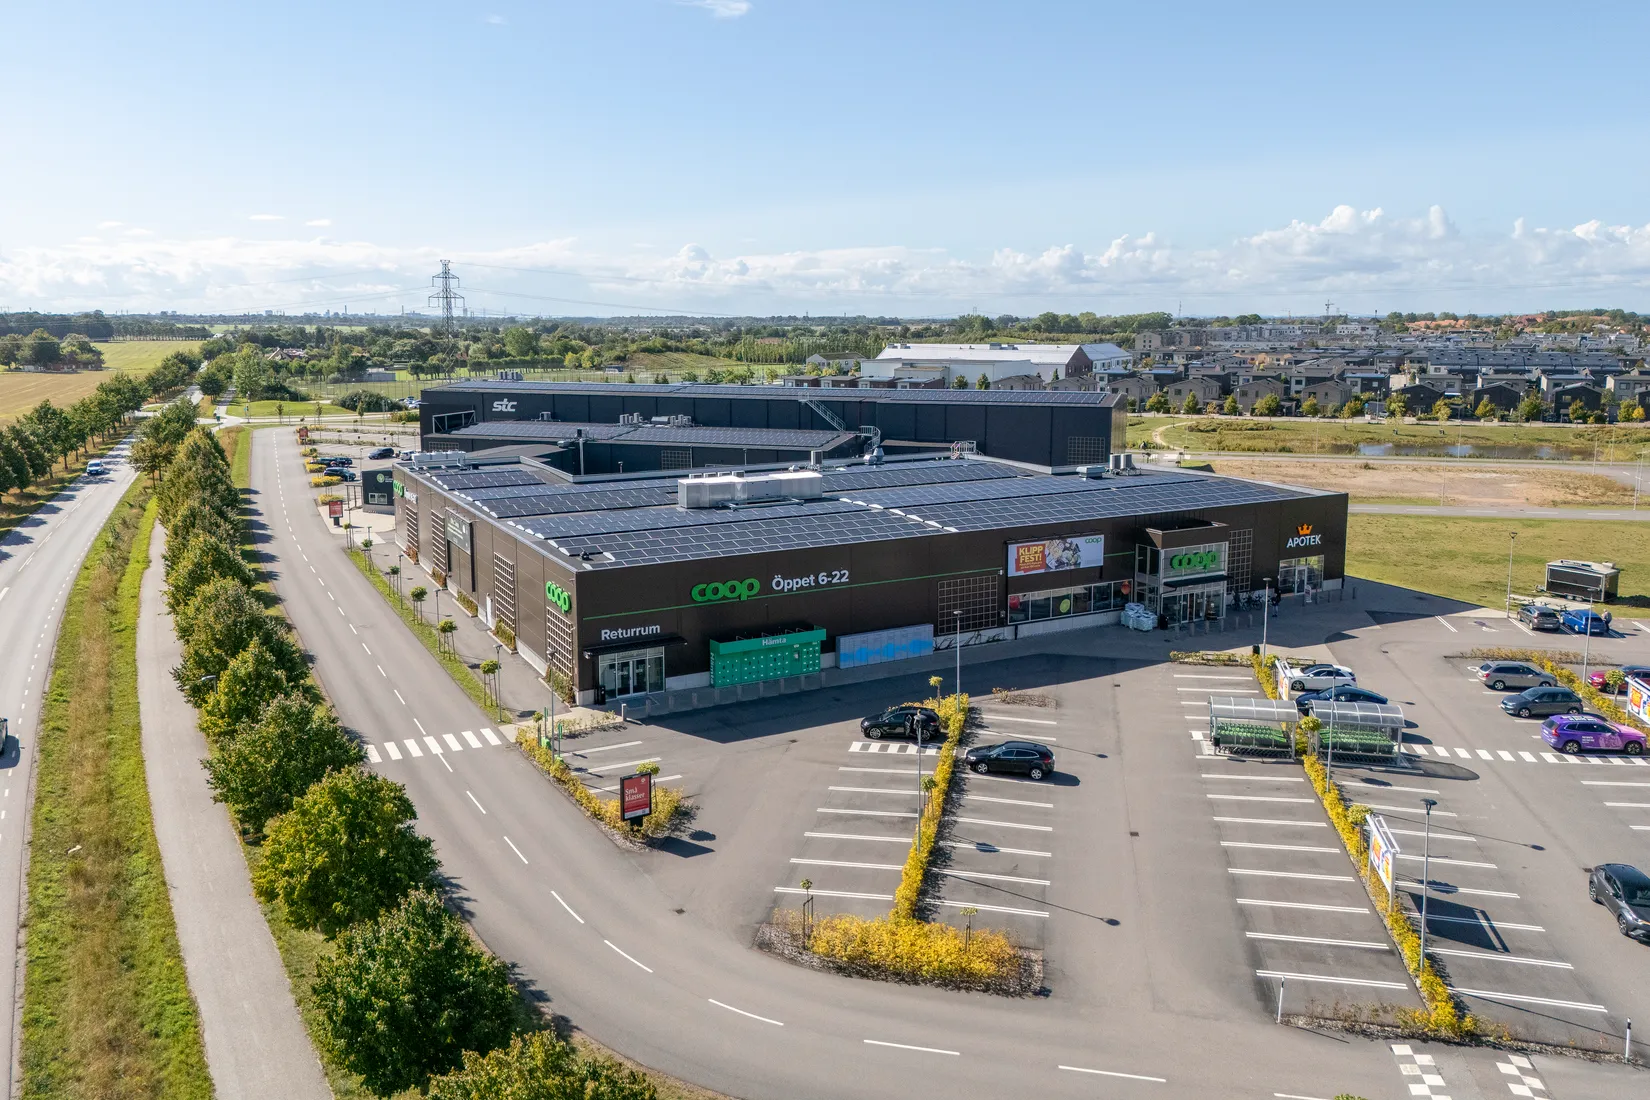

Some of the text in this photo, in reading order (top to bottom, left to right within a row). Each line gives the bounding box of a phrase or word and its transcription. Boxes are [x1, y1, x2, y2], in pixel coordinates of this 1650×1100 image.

[492, 398, 517, 411] stc
[1287, 535, 1321, 548] APOTEK
[1019, 546, 1043, 555] KLIPP
[1020, 554, 1042, 563] FEST!
[1170, 550, 1218, 574] coop
[772, 570, 849, 592] Öppet 6-22
[691, 578, 760, 601] coop
[546, 581, 571, 614] coop
[601, 625, 660, 640] Returrum
[762, 638, 787, 646] Hämta
[625, 787, 638, 795] Små
